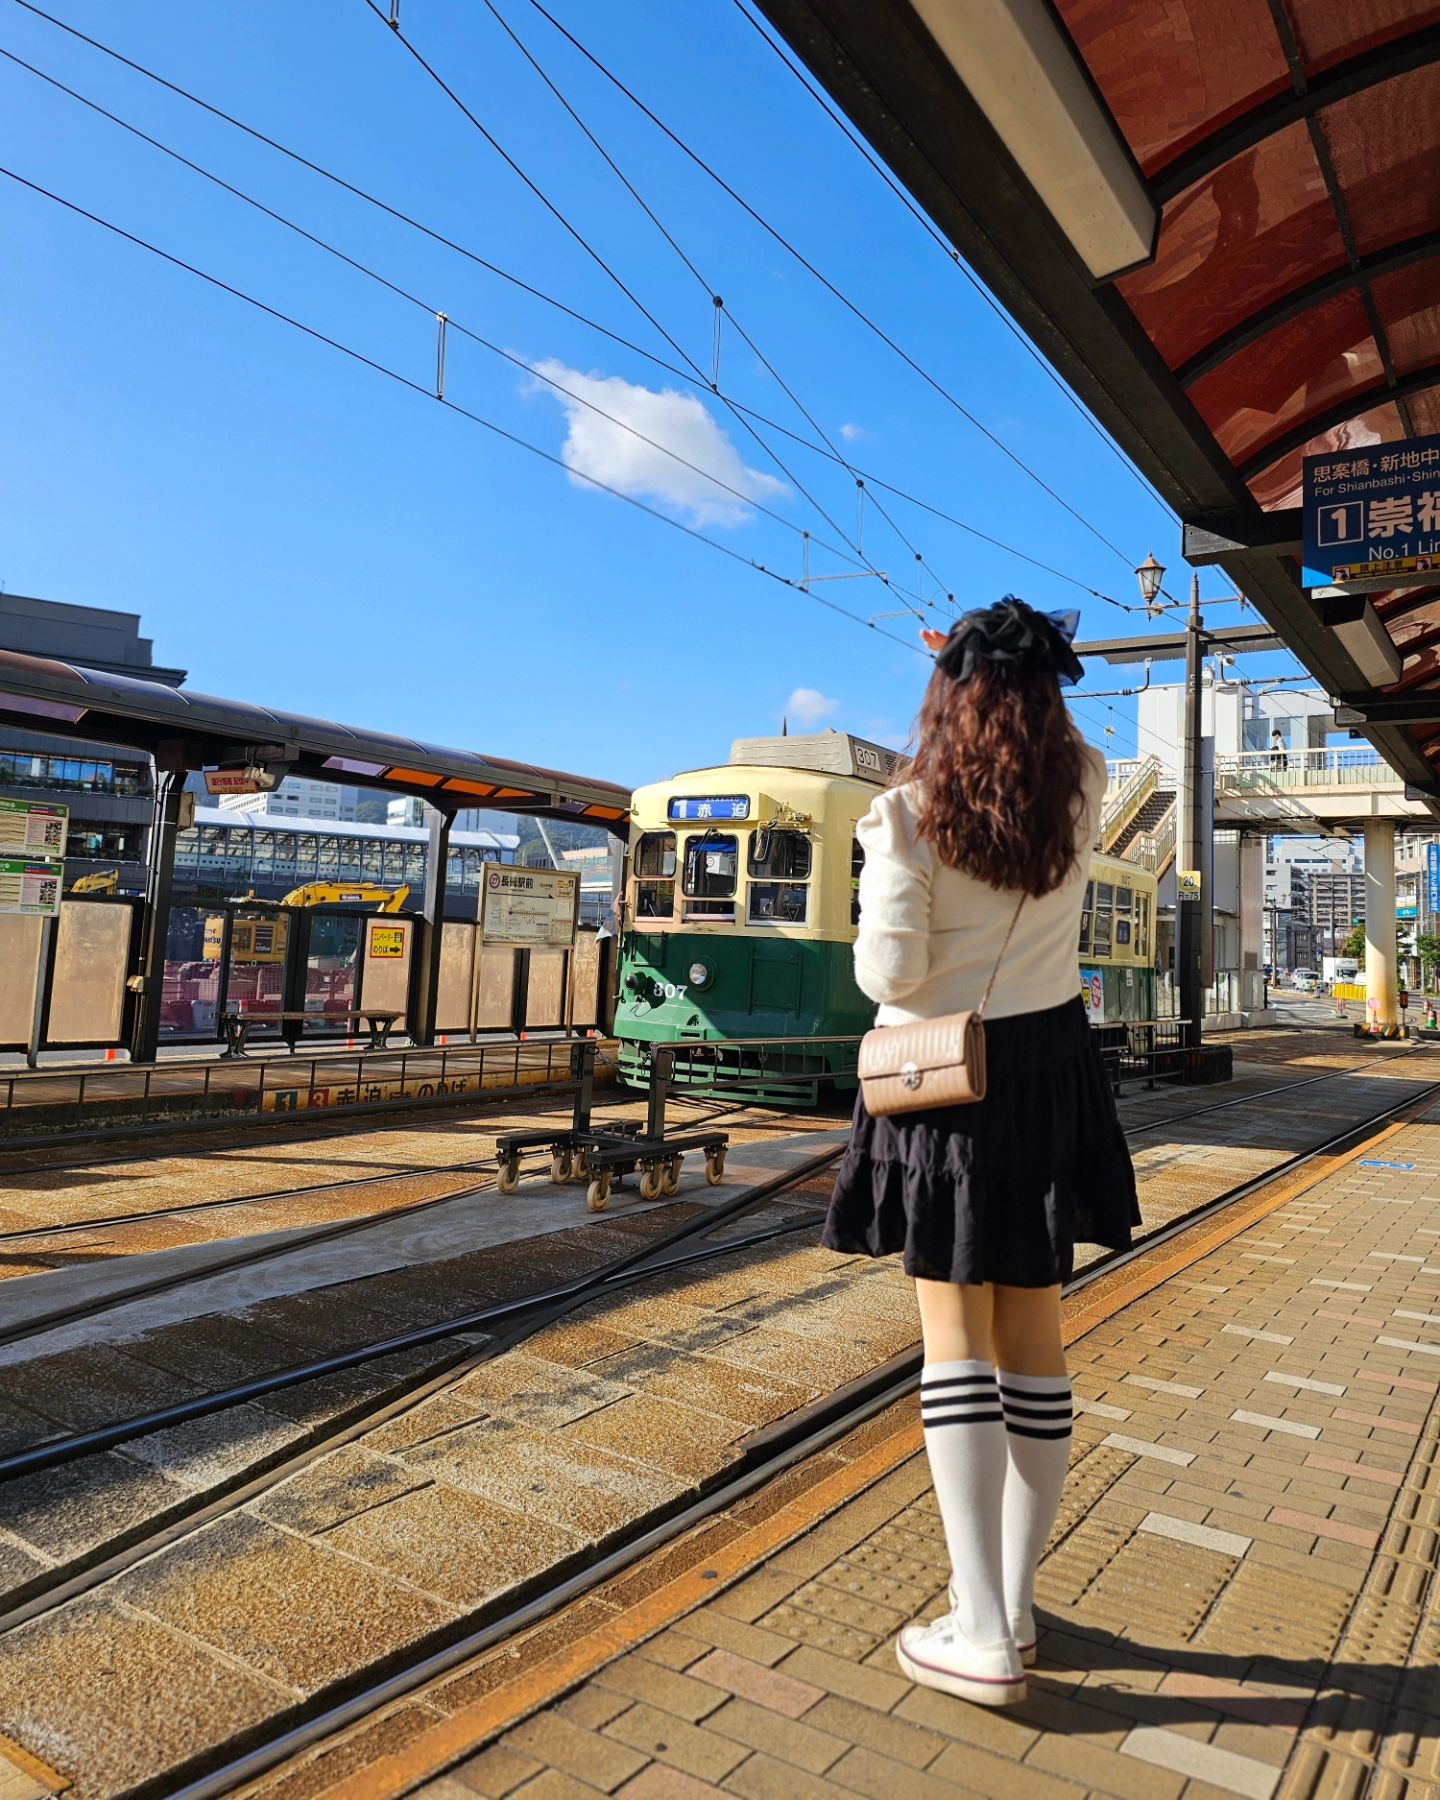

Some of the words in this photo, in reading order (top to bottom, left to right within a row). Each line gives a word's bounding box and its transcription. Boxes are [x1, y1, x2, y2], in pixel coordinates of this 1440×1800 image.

[1315, 485, 1334, 497] For
[1331, 508, 1347, 539] 1
[1369, 543, 1409, 561] No.1
[857, 748, 877, 768] 307
[674, 799, 687, 819] 1
[1183, 876, 1195, 887] 20
[1178, 891, 1199, 901] R=75
[653, 982, 688, 1000] 307
